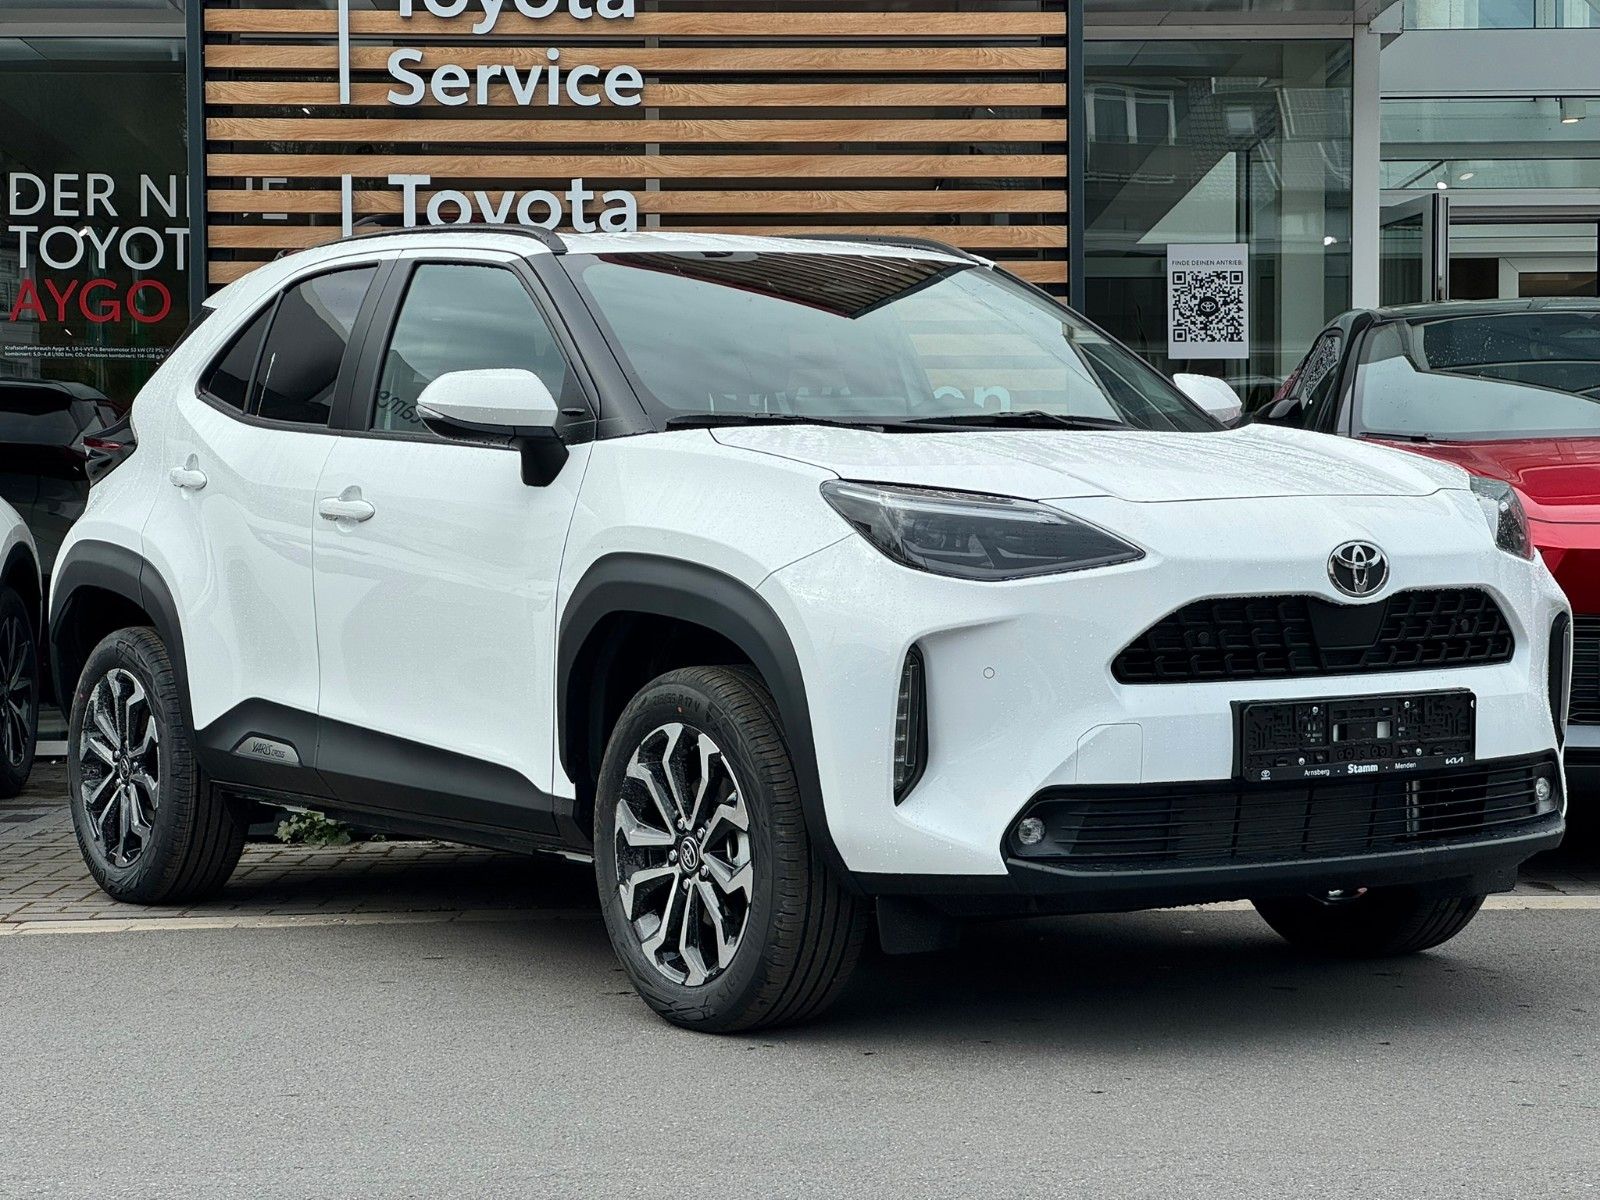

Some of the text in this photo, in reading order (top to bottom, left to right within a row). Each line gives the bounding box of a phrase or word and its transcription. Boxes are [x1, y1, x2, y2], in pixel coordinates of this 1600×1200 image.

[387, 48, 645, 106] Service
[9, 172, 119, 217] DER
[387, 174, 638, 232] Toyota
[8, 225, 191, 270] TOYOT
[8, 279, 172, 323] AYGO
[252, 742, 273, 756] YARIS
[1304, 761, 1417, 776] Arnsberg Stamm Menden
